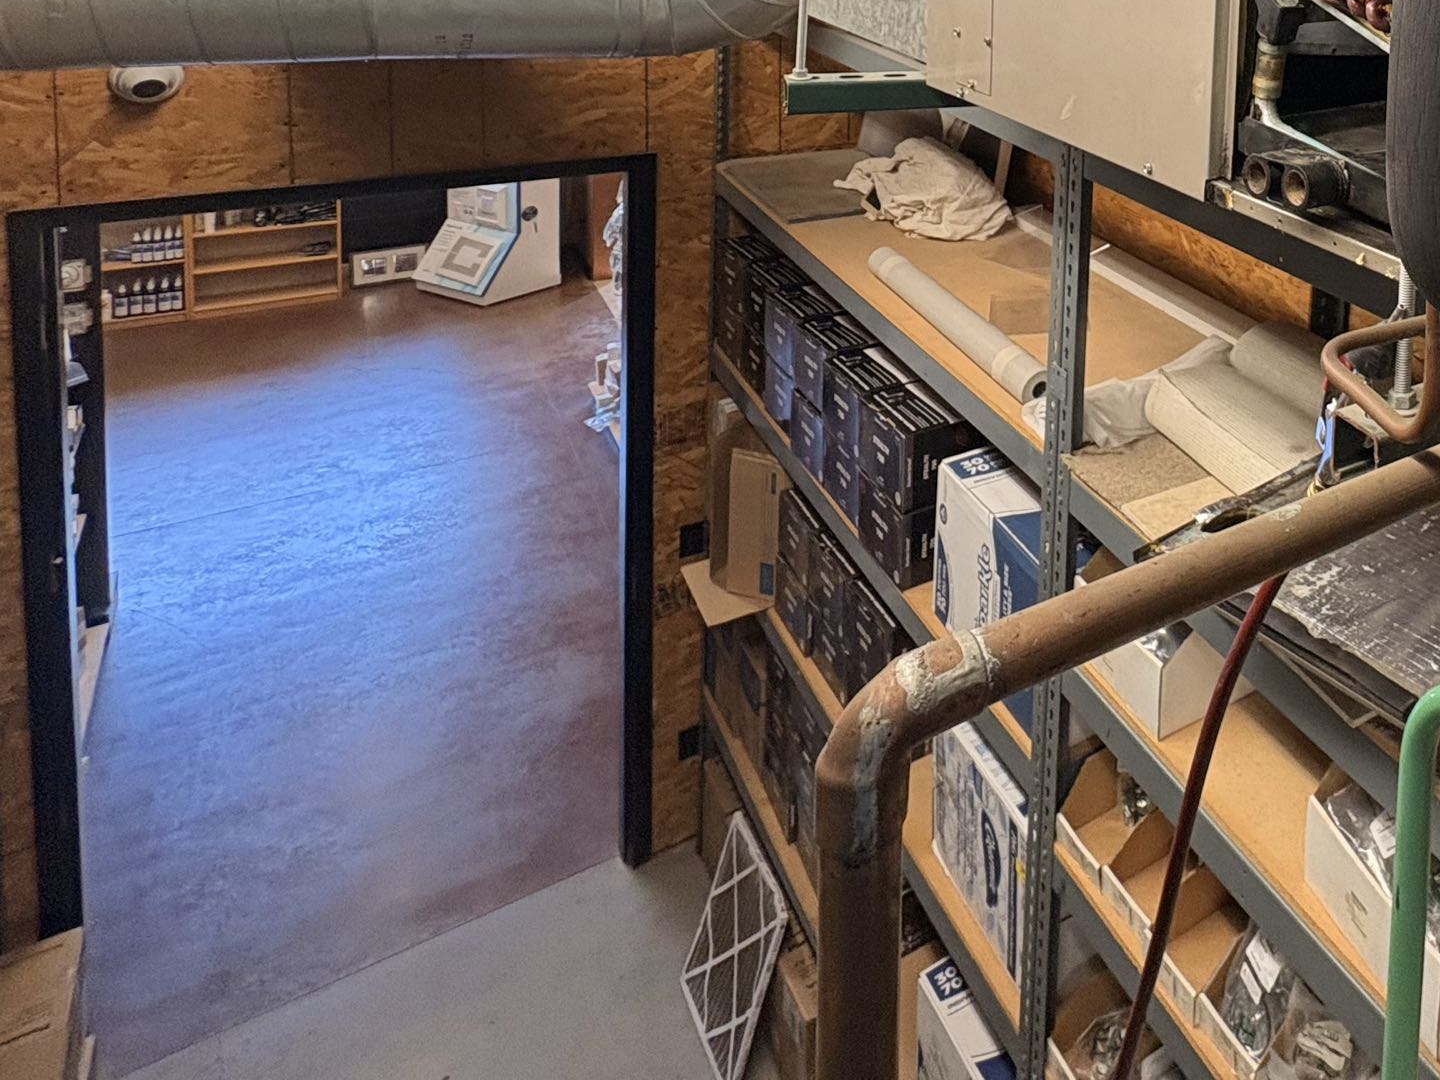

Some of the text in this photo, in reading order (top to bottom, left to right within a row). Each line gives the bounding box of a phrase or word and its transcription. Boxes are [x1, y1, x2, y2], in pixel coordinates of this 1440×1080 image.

[959, 457, 985, 469] 30
[968, 463, 990, 476] 70
[933, 966, 957, 985] 30
[940, 976, 963, 996] 70
